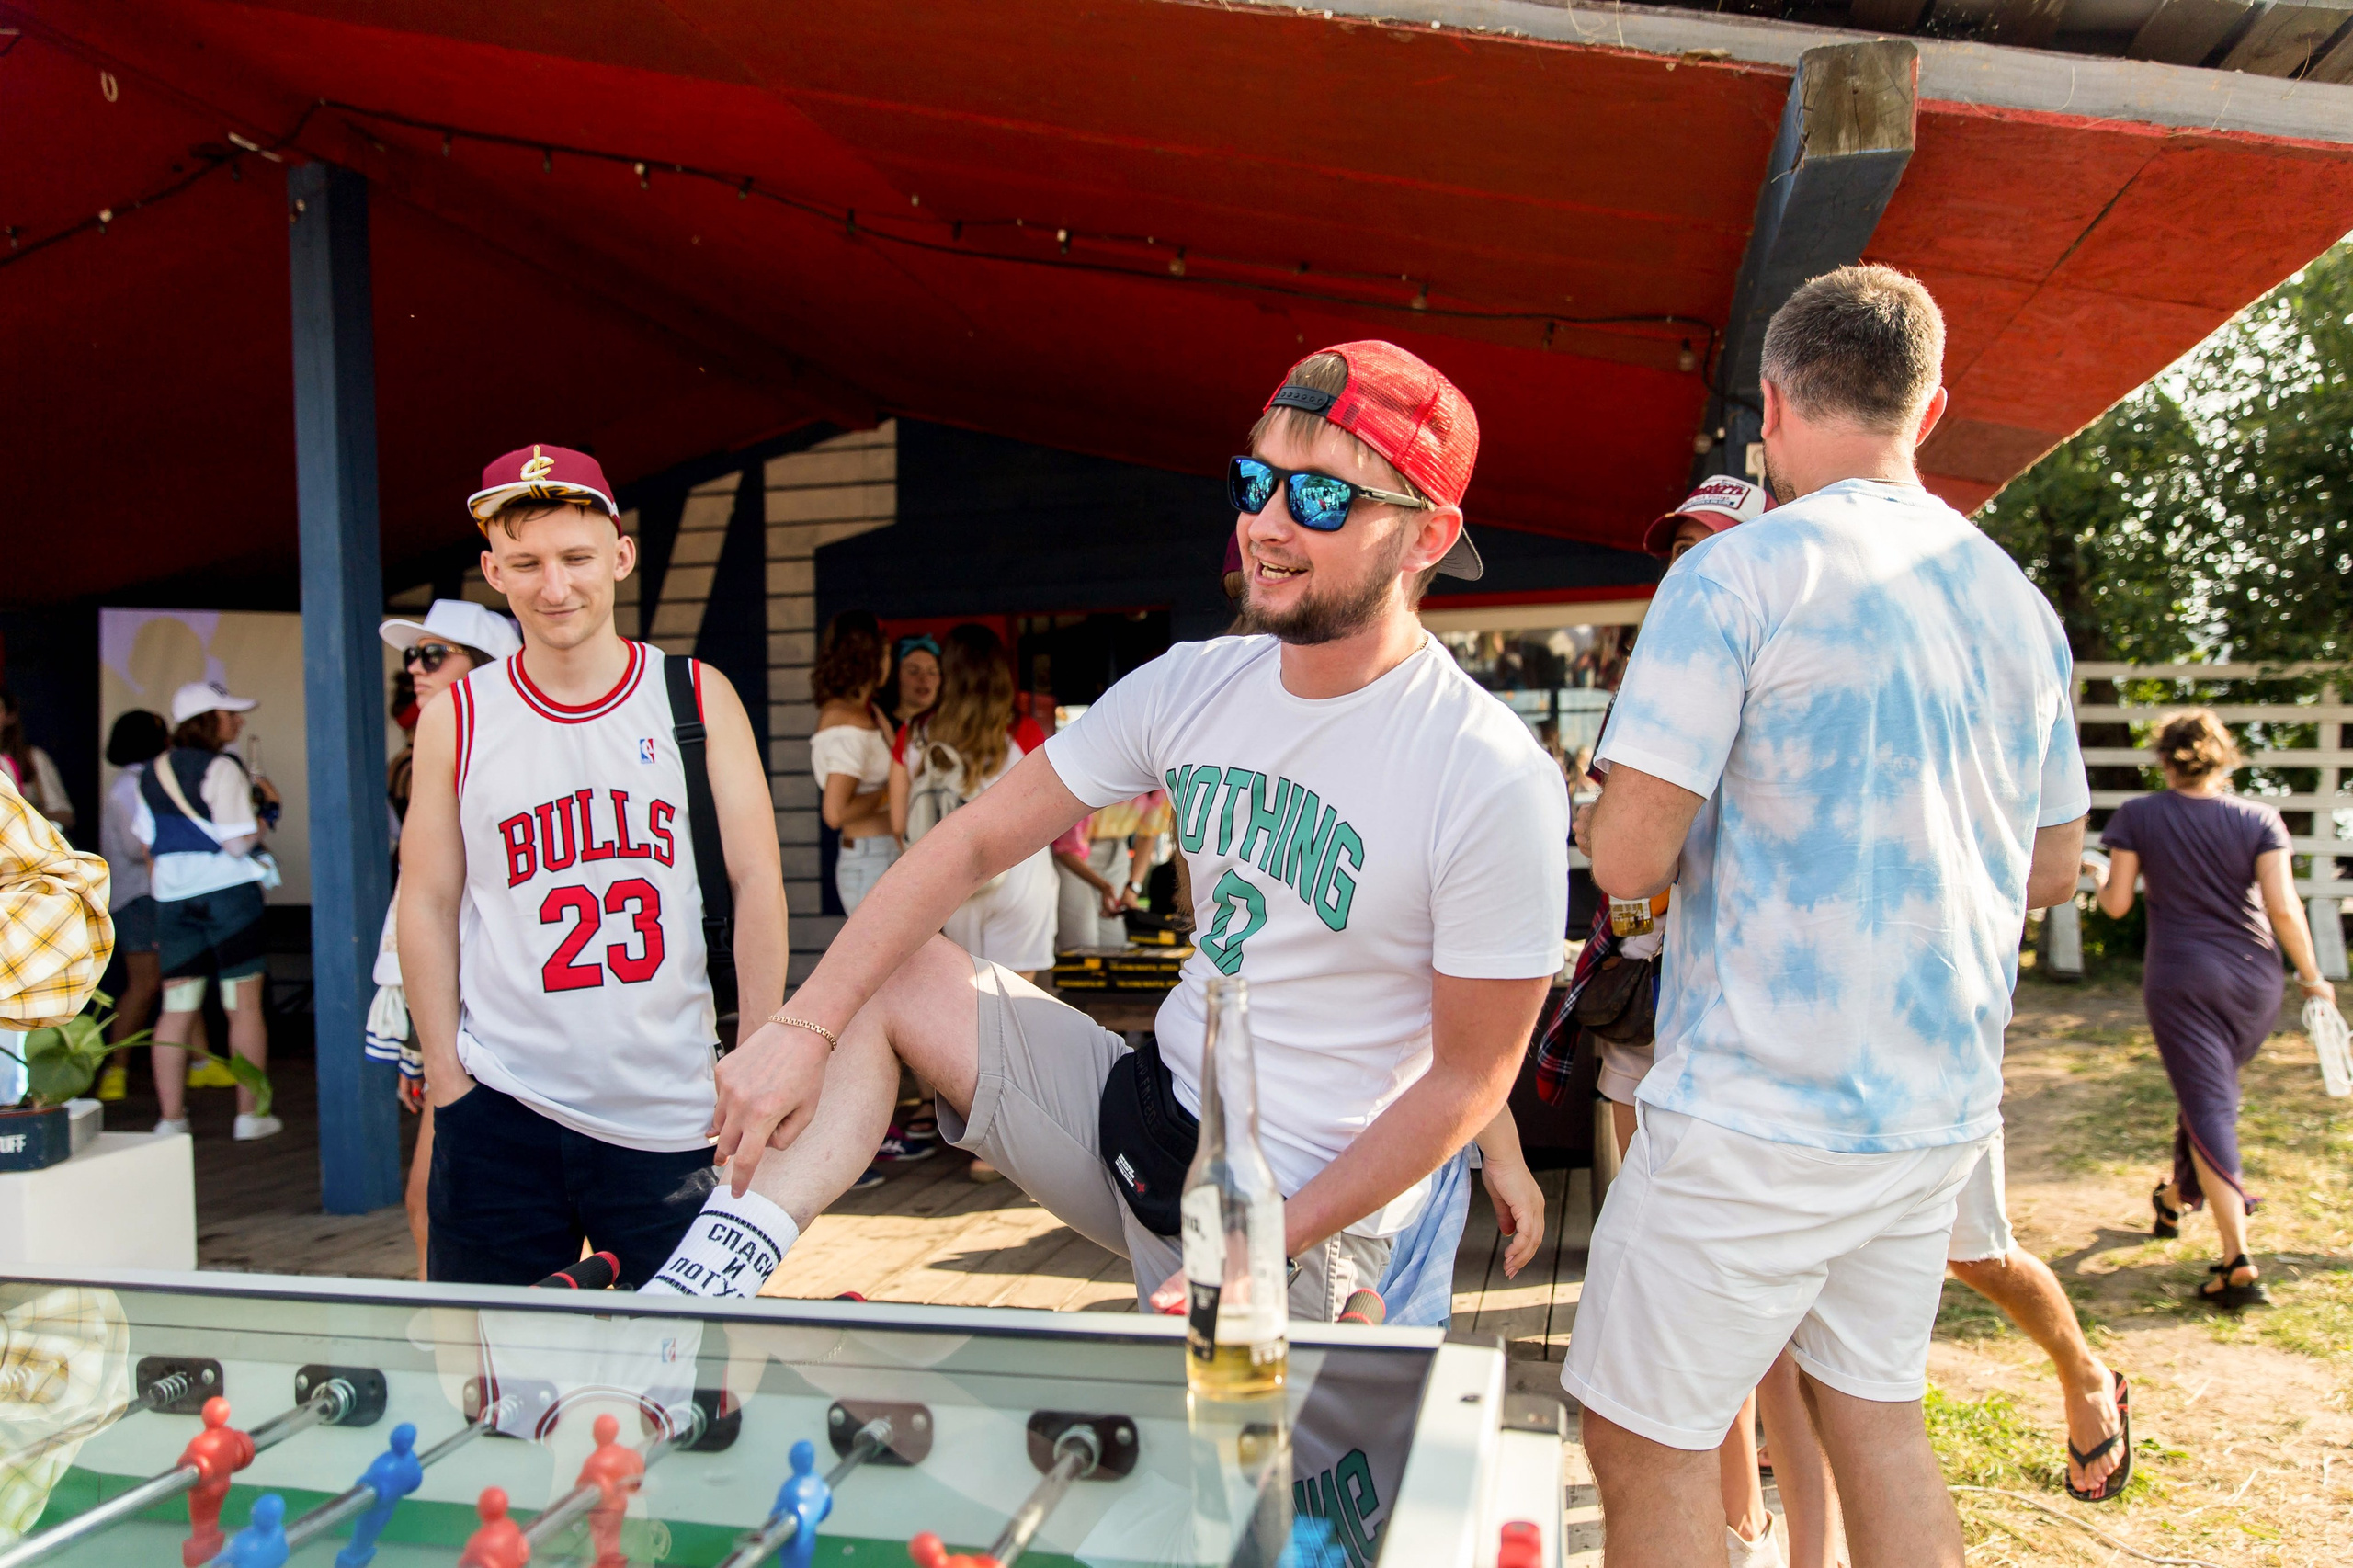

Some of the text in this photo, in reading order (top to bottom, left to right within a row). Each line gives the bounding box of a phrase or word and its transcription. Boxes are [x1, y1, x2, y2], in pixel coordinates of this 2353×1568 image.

[498, 788, 676, 889] BULLS
[540, 878, 665, 993] 23
[669, 1257, 745, 1298] ПОТУ
[722, 1256, 746, 1280] И
